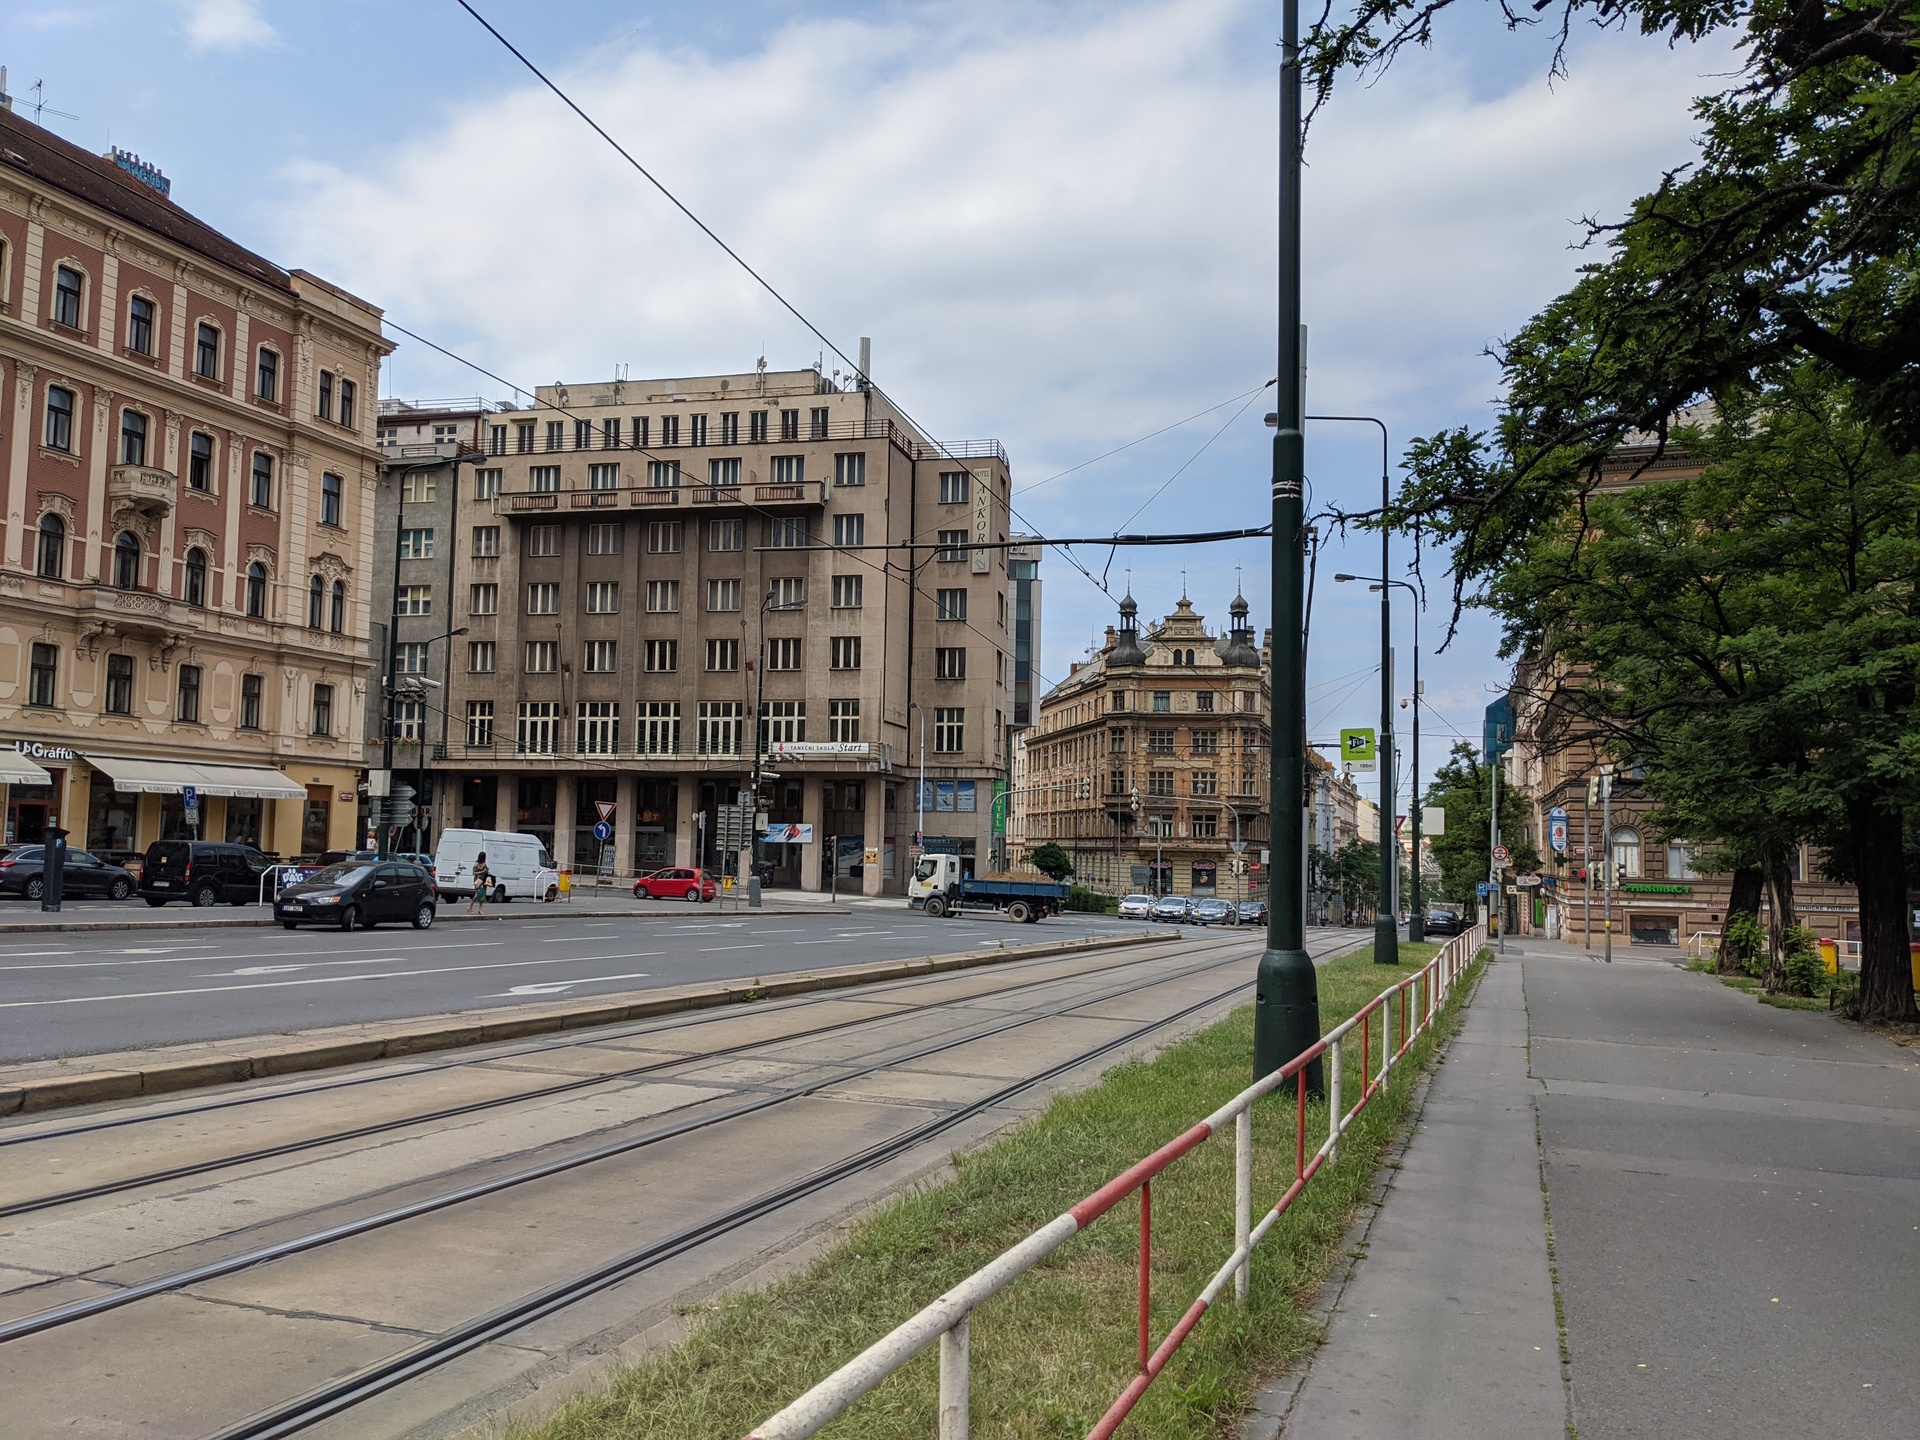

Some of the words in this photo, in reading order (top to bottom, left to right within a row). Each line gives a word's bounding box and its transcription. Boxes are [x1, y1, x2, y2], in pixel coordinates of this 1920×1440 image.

[976, 485, 987, 555] ANKORA
[838, 743, 862, 752] Start
[186, 788, 193, 801] P
[1622, 884, 1692, 894] PHARMACY
